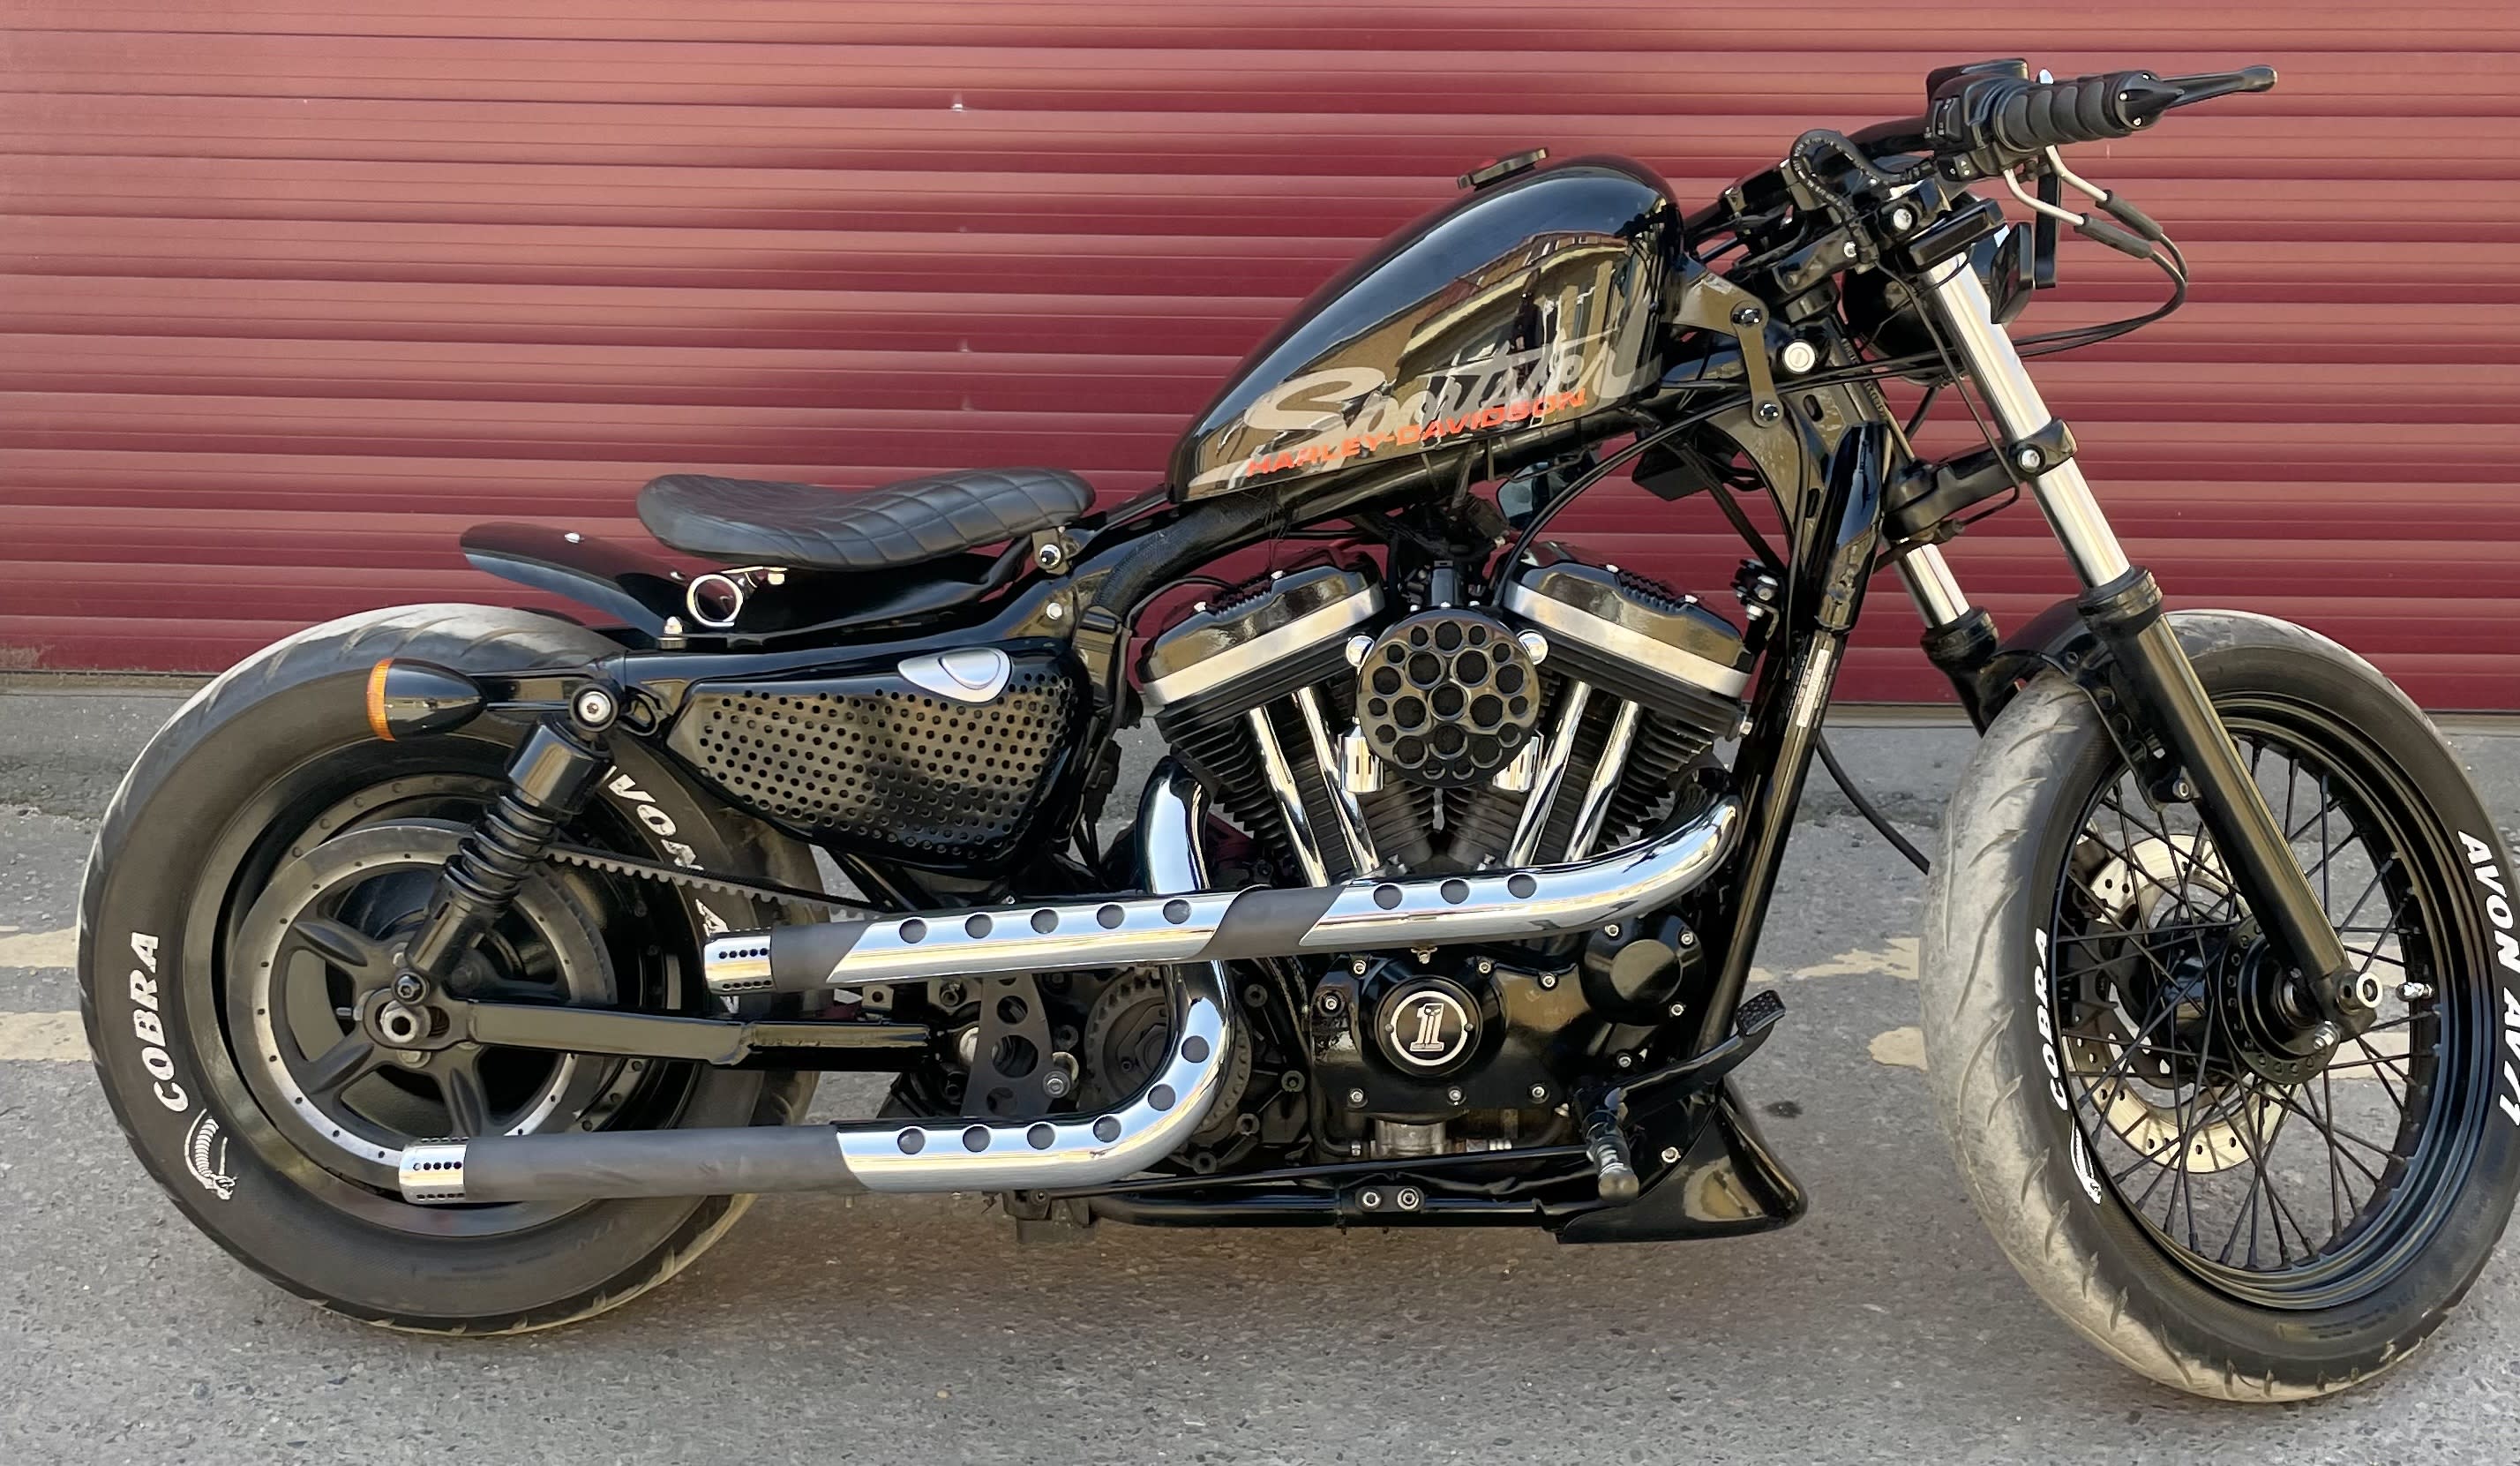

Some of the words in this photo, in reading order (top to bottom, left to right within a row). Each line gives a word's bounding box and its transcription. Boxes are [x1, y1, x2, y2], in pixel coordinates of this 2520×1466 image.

[1246, 388, 1587, 478] HARLEY-DAVIDSON
[602, 764, 705, 870] VON
[2457, 830, 2520, 974] AVON
[130, 930, 189, 1112] COBRA
[2034, 927, 2068, 1111] COBRA
